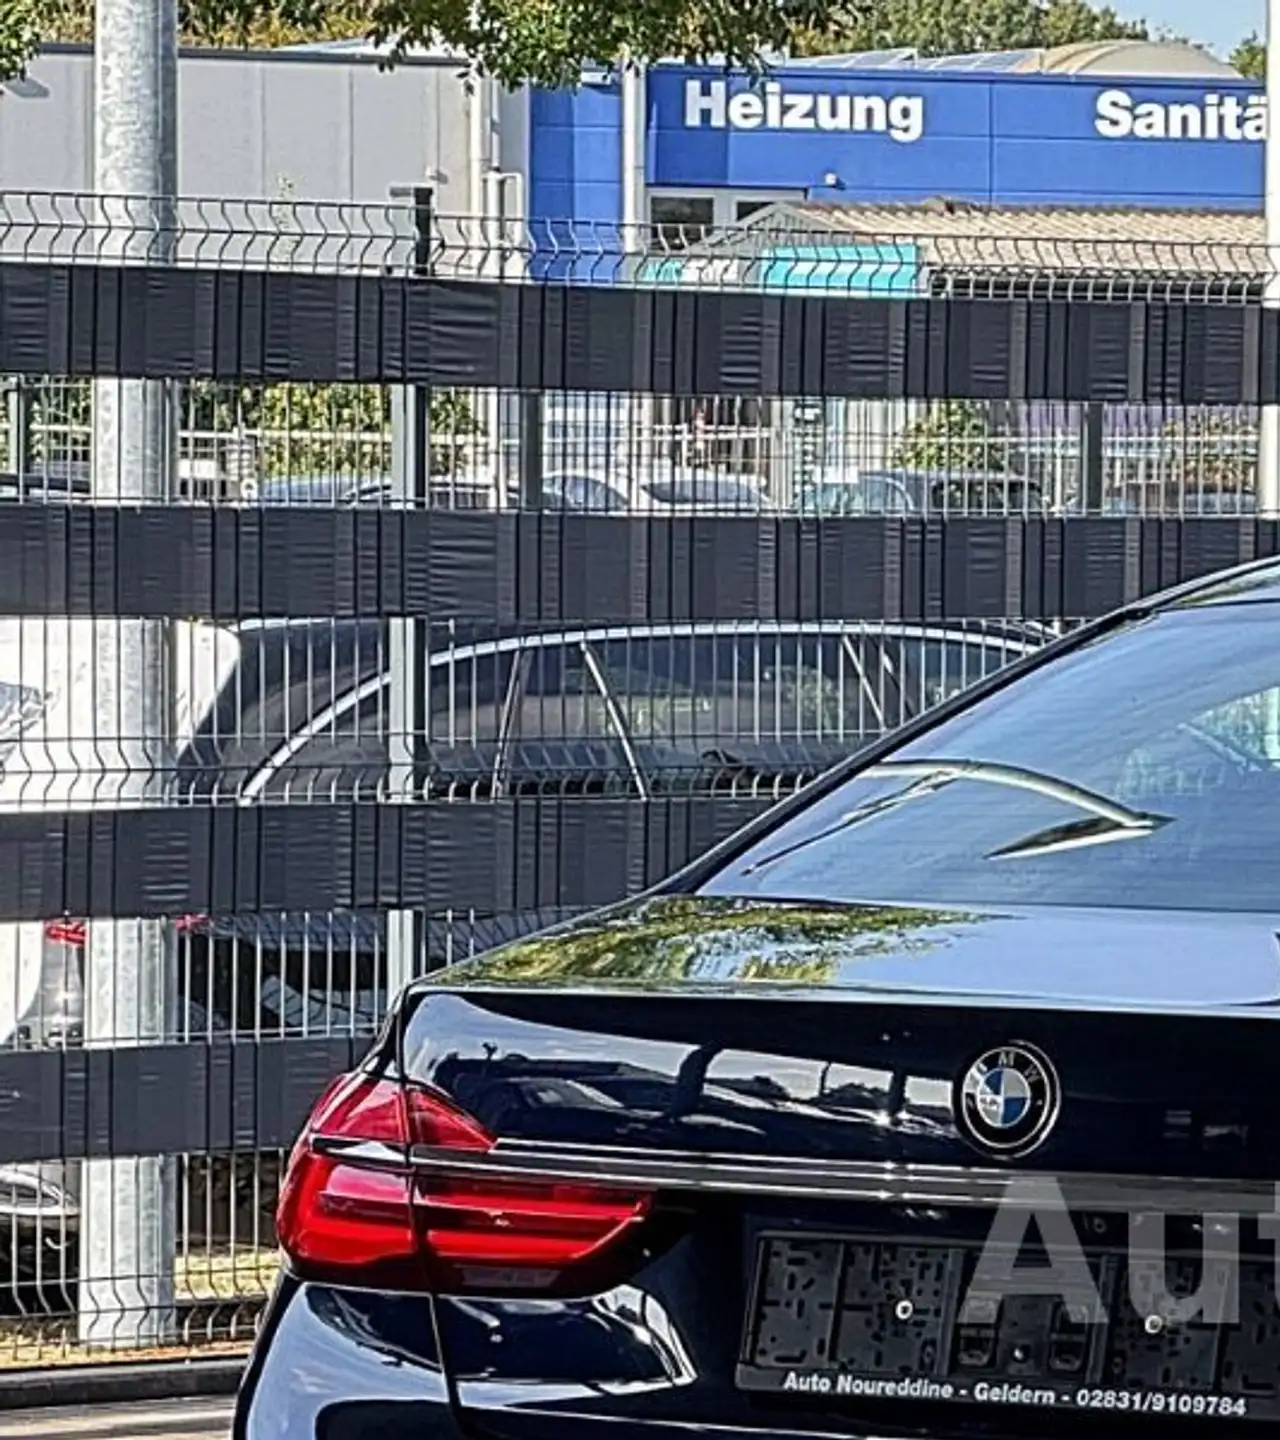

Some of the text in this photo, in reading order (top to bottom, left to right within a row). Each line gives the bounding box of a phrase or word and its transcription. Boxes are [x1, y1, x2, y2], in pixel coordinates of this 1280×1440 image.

[684, 80, 923, 143] Heizung
[1094, 89, 1268, 140] Sanitä
[782, 1371, 831, 1393] Auto
[836, 1374, 953, 1399] Noureddine
[974, 1382, 1055, 1404] Geldern
[1076, 1388, 1246, 1415] 02831/9109784
